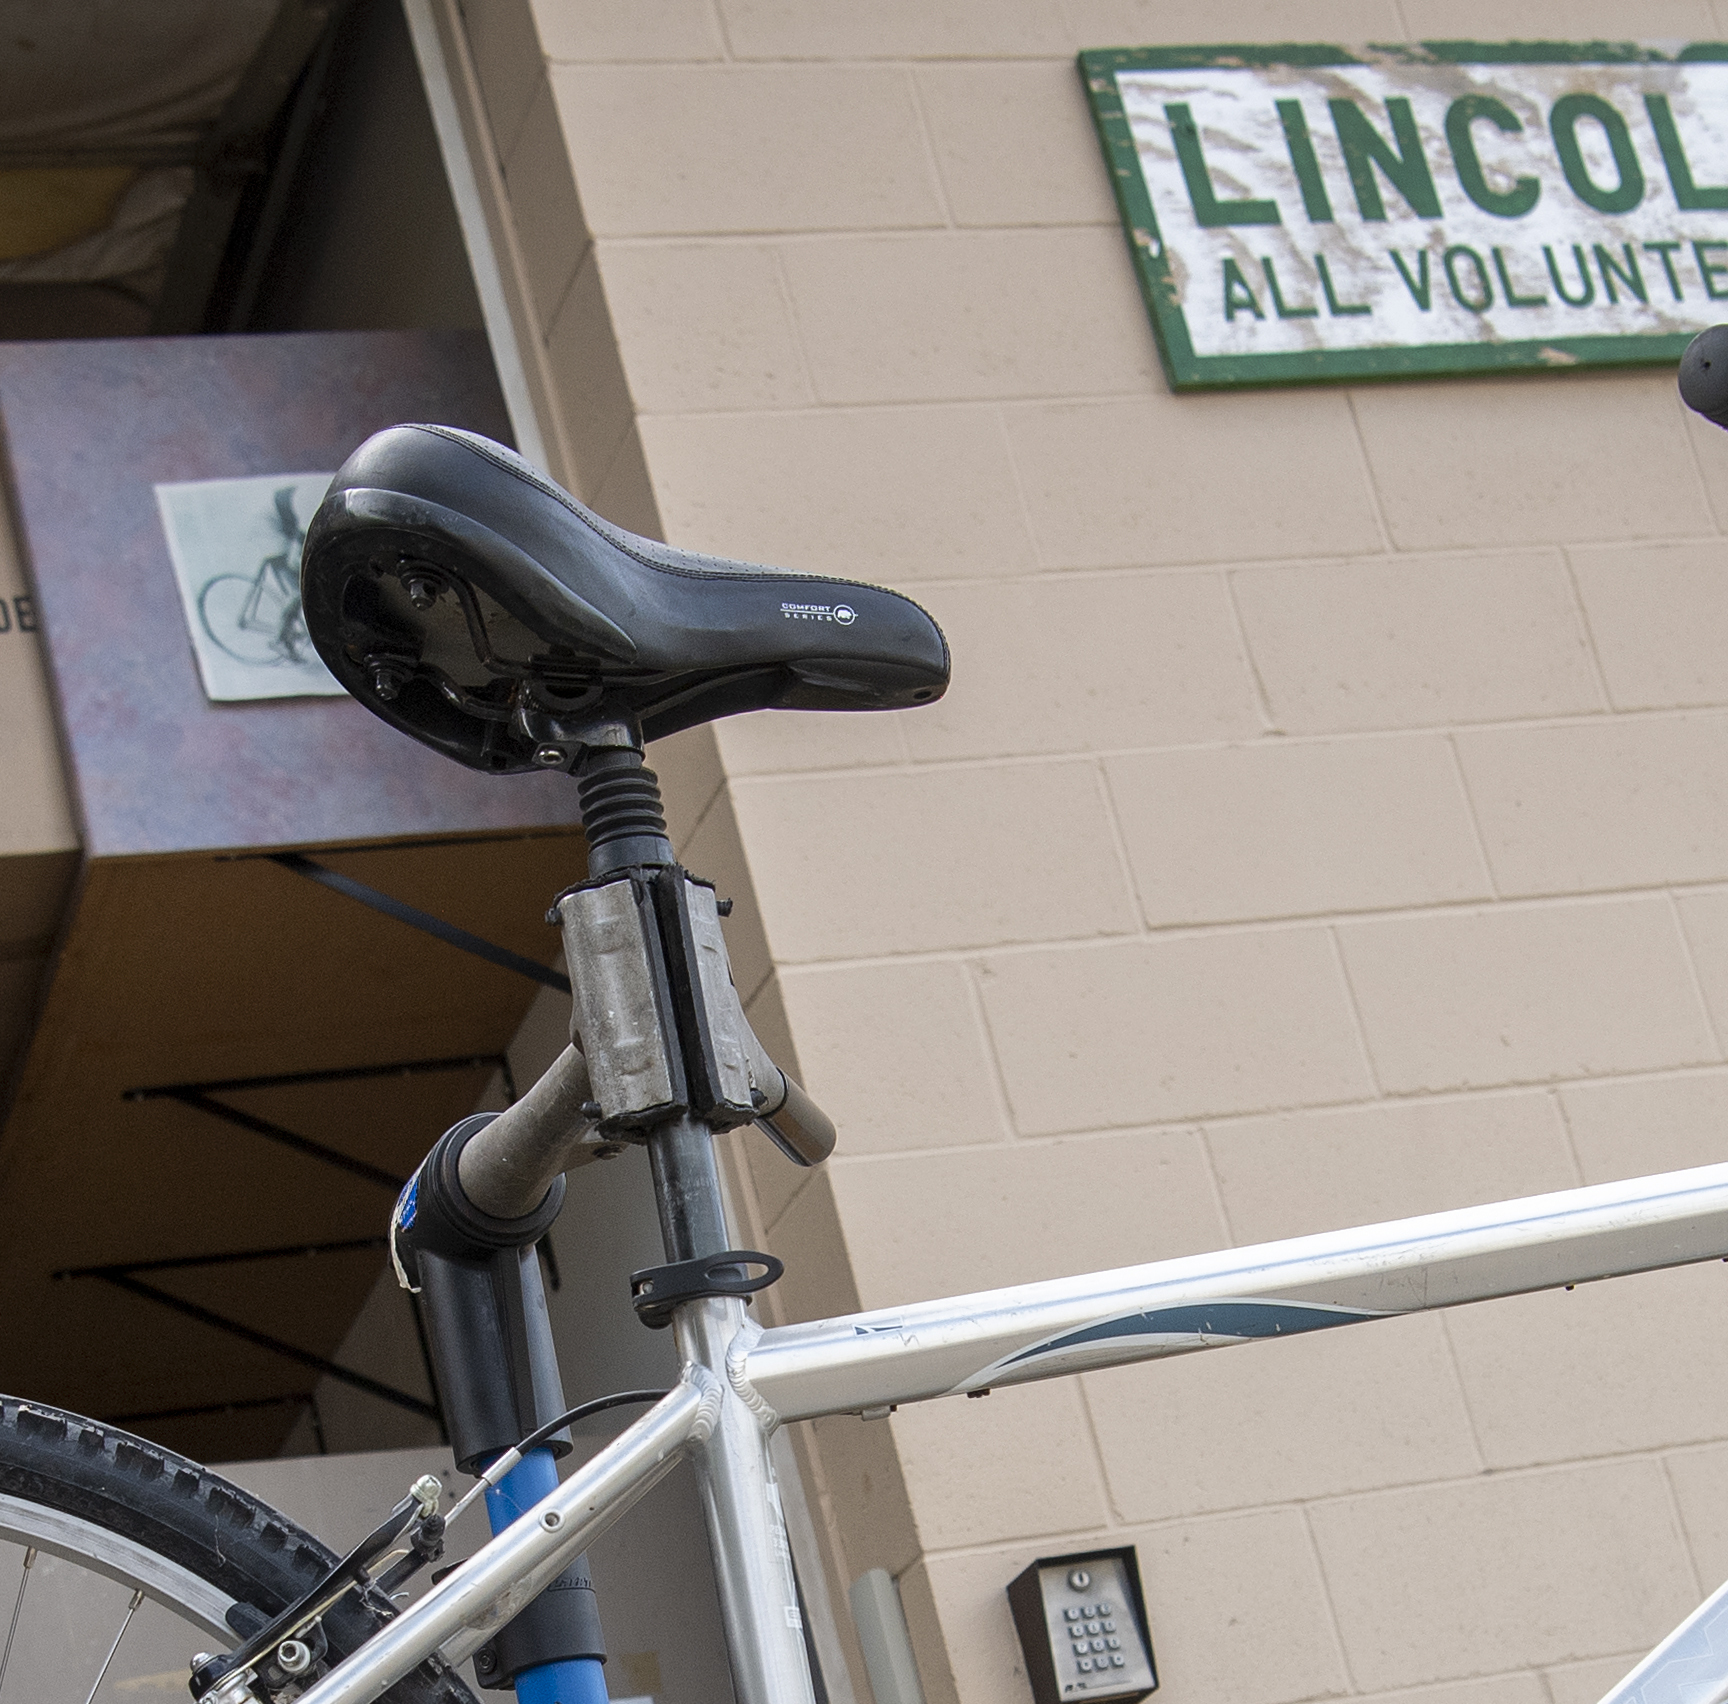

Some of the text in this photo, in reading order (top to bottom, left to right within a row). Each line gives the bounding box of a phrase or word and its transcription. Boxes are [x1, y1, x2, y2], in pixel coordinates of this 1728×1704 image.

[1221, 253, 1373, 323] ALL
[781, 602, 831, 612] COMFORT
[784, 612, 833, 622] SERIES
